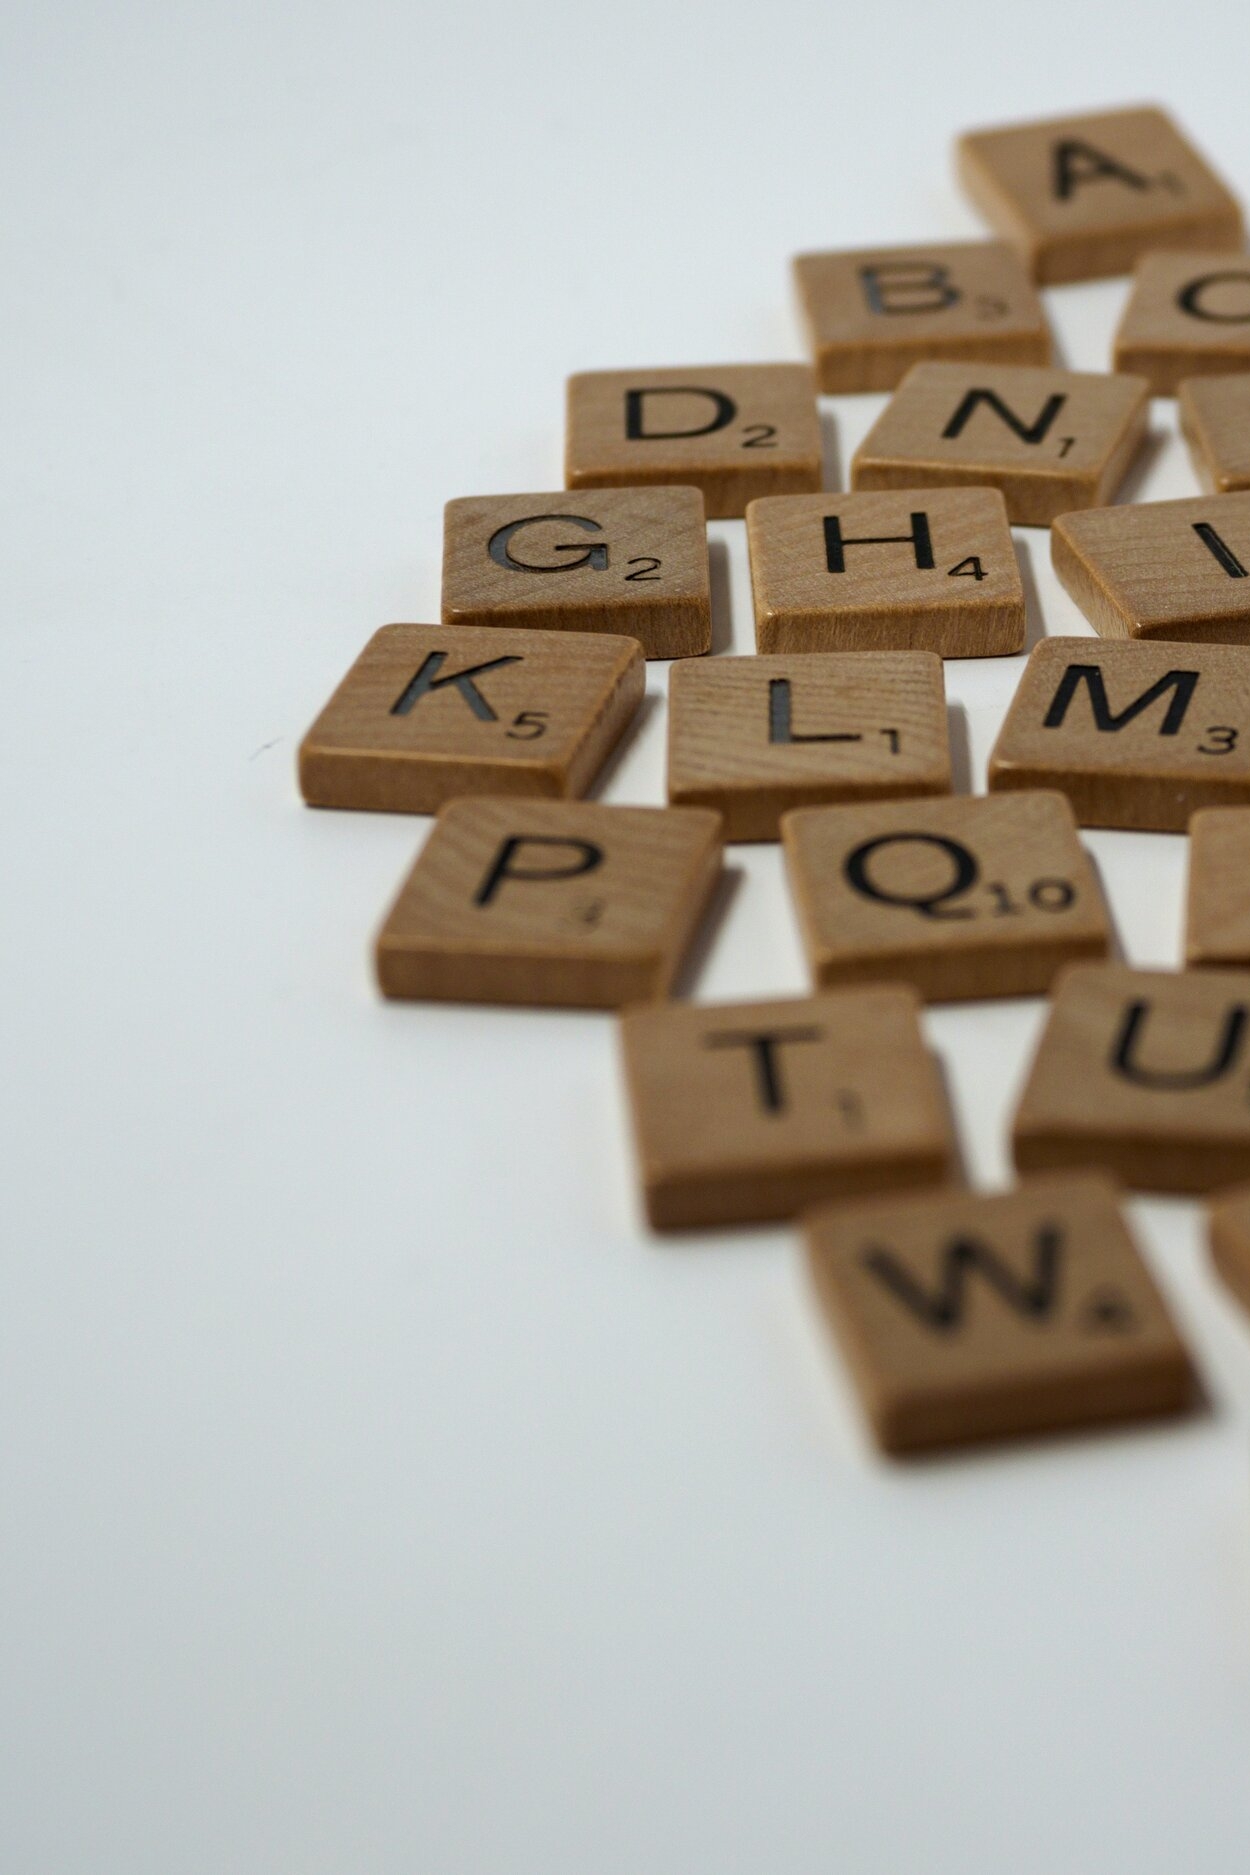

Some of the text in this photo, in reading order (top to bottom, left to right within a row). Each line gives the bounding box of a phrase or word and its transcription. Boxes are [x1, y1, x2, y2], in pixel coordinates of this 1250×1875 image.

[1051, 139, 1149, 203] A
[859, 261, 959, 316] B
[625, 386, 778, 449] D 2
[941, 388, 1075, 459] N 1
[487, 513, 661, 582] G 2
[823, 511, 989, 582] H 4
[1192, 522, 1250, 579] I
[389, 651, 551, 741] K 5
[768, 678, 900, 756] L 1
[1042, 663, 1238, 755] M 3
[472, 833, 605, 909] P
[842, 831, 1076, 920] Q 10
[703, 1026, 825, 1117] T
[858, 1225, 1064, 1338] W
